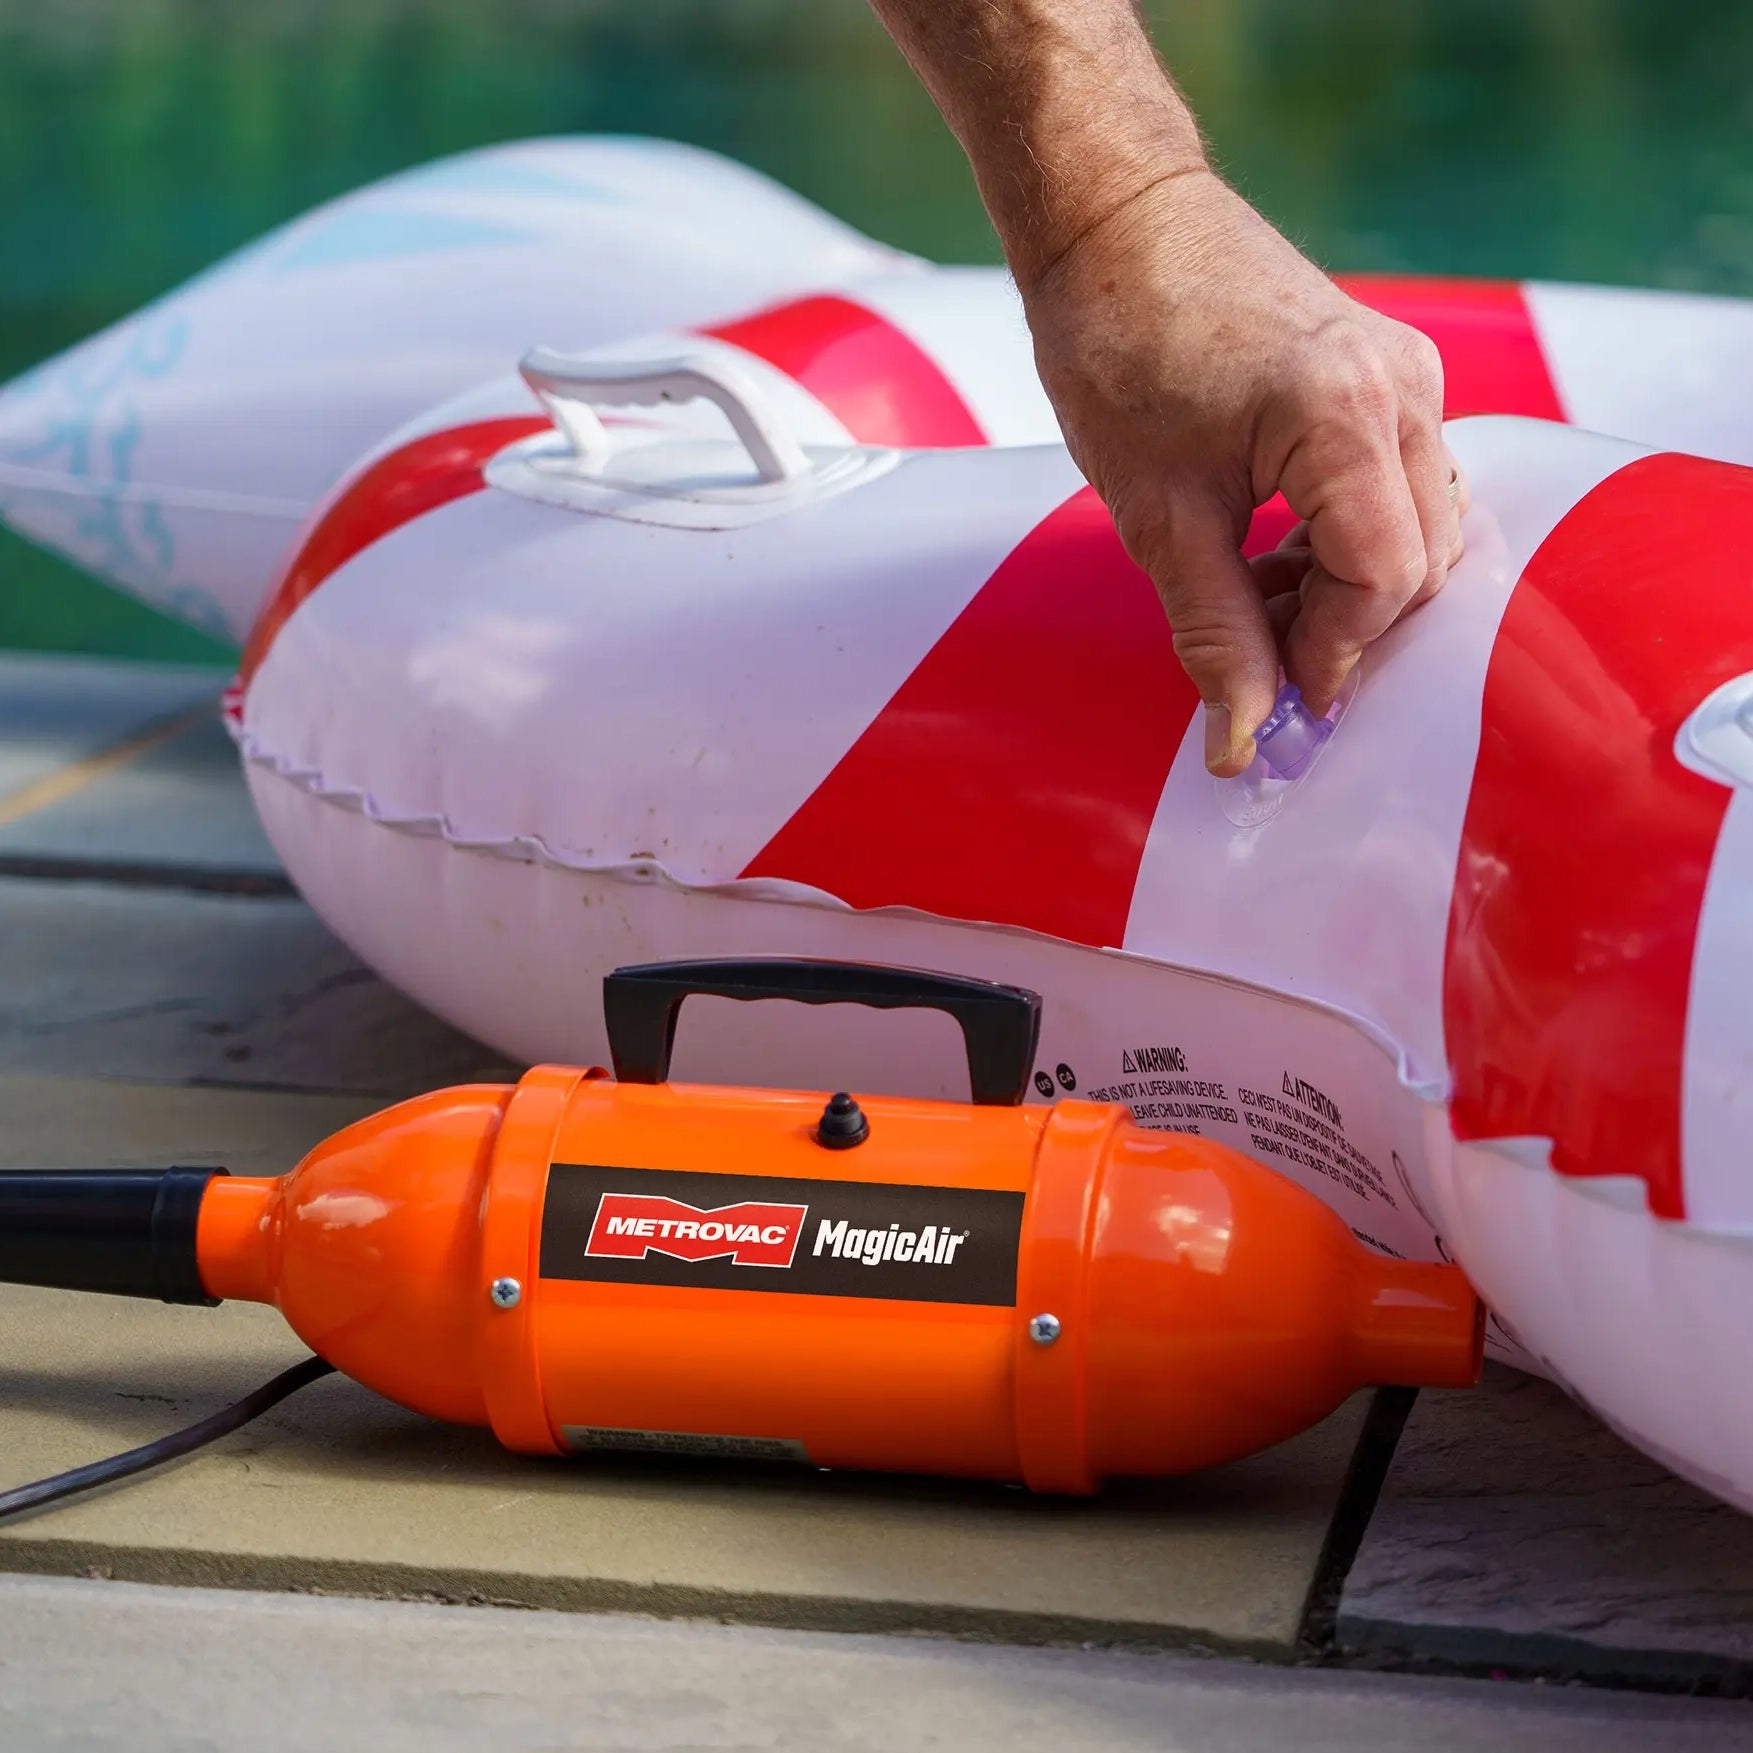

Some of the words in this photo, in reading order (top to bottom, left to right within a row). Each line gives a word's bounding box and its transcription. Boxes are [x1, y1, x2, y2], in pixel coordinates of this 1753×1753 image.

[1133, 1047, 1189, 1073] WARNING:
[1037, 1078, 1051, 1091] US
[1059, 1071, 1073, 1083] CA
[1088, 1088, 1110, 1102] THIS
[1108, 1085, 1120, 1101] IS
[1118, 1083, 1138, 1099] NOT
[1138, 1082, 1147, 1097] A
[1145, 1080, 1195, 1097] LIFESAVING
[1193, 1081, 1228, 1100] DEVICE.
[1130, 1104, 1159, 1120] LEAVE
[1157, 1103, 1184, 1118] CHILD
[1182, 1104, 1239, 1123] UNATTENDED
[1238, 1088, 1257, 1107] CECI
[1276, 1099, 1293, 1120] PAS
[1291, 1105, 1303, 1125] UN
[1295, 1076, 1344, 1131] ATTENTION:
[1243, 1111, 1257, 1128] NE
[1255, 1114, 1272, 1133] PAS
[1270, 1118, 1301, 1144] LAISSER
[1250, 1133, 1286, 1157] PENDANT
[1284, 1144, 1303, 1164] QUE
[606, 1217, 786, 1245] METROVAC
[812, 1219, 965, 1266] MagicAir
